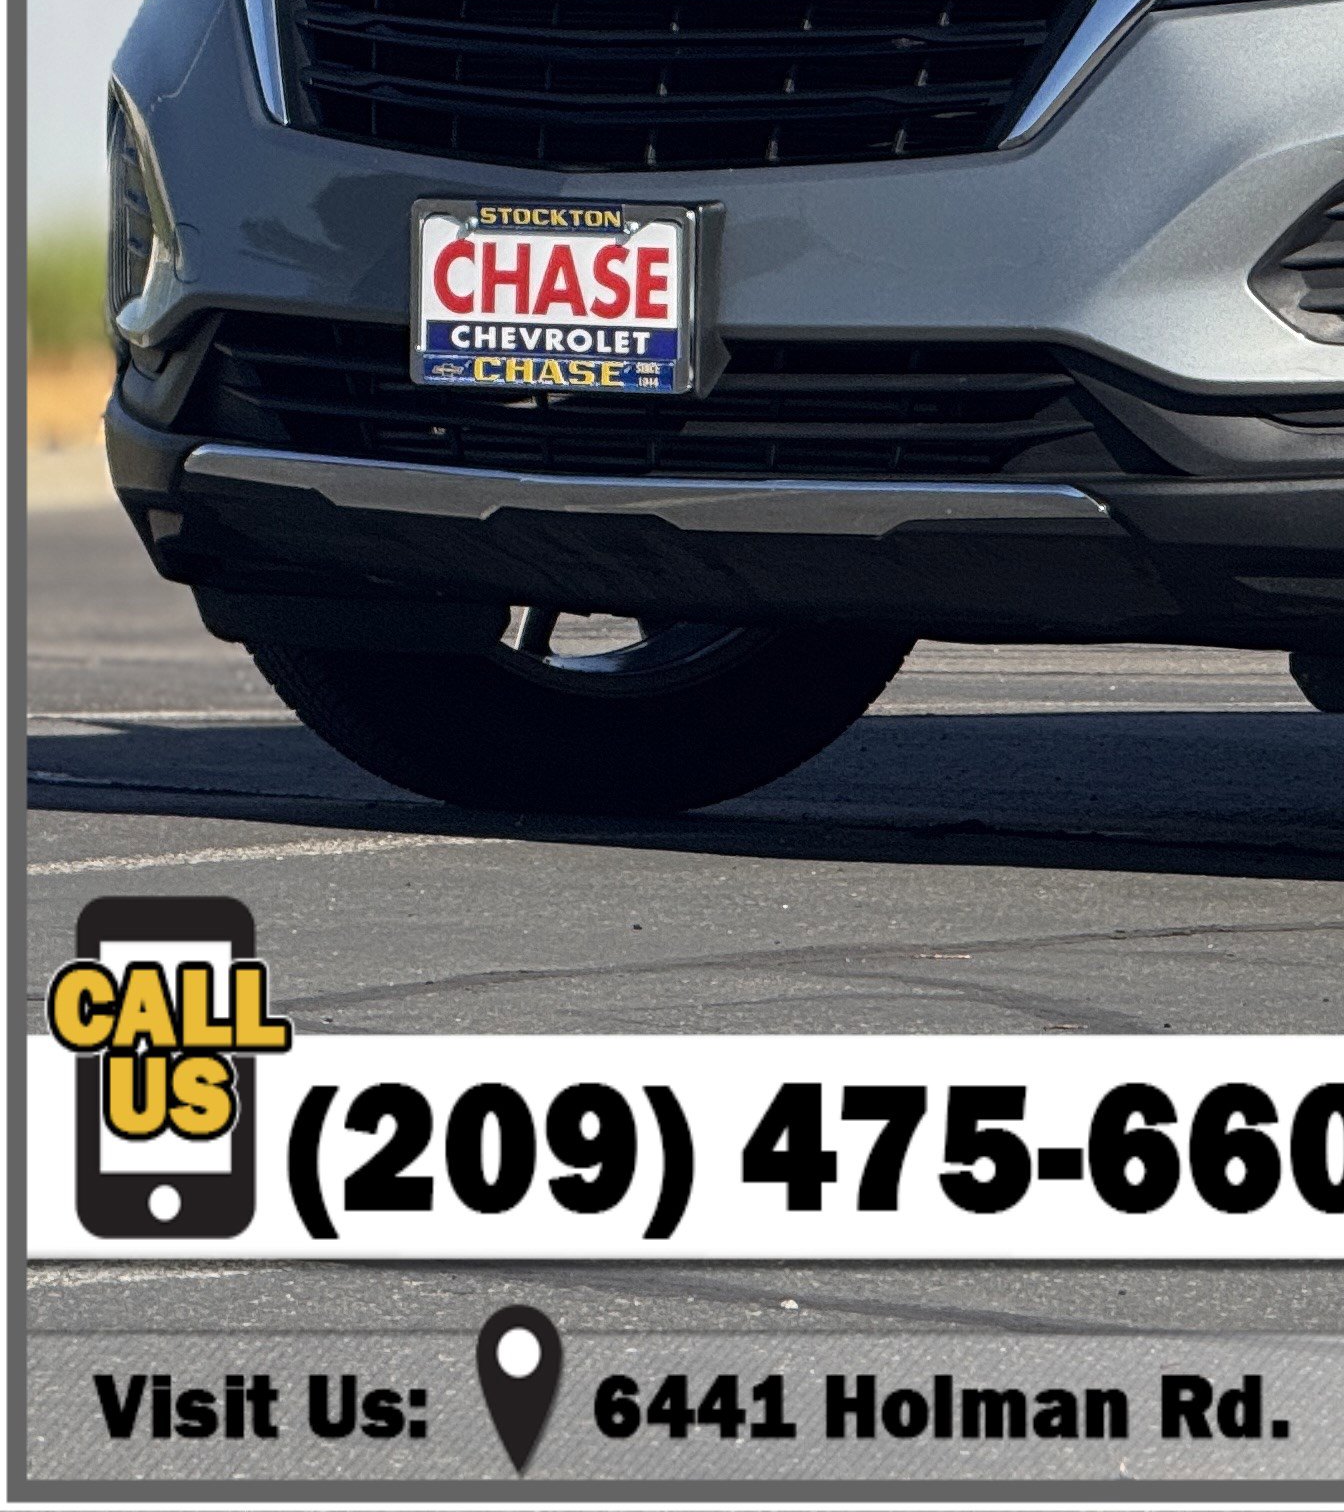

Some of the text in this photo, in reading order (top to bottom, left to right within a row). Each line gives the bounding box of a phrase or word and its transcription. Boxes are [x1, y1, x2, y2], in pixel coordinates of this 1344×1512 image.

[480, 206, 622, 228] STOCKTON
[433, 237, 670, 320] CHASE
[451, 324, 650, 355] CHEVROLET
[473, 355, 626, 388] CHASE
